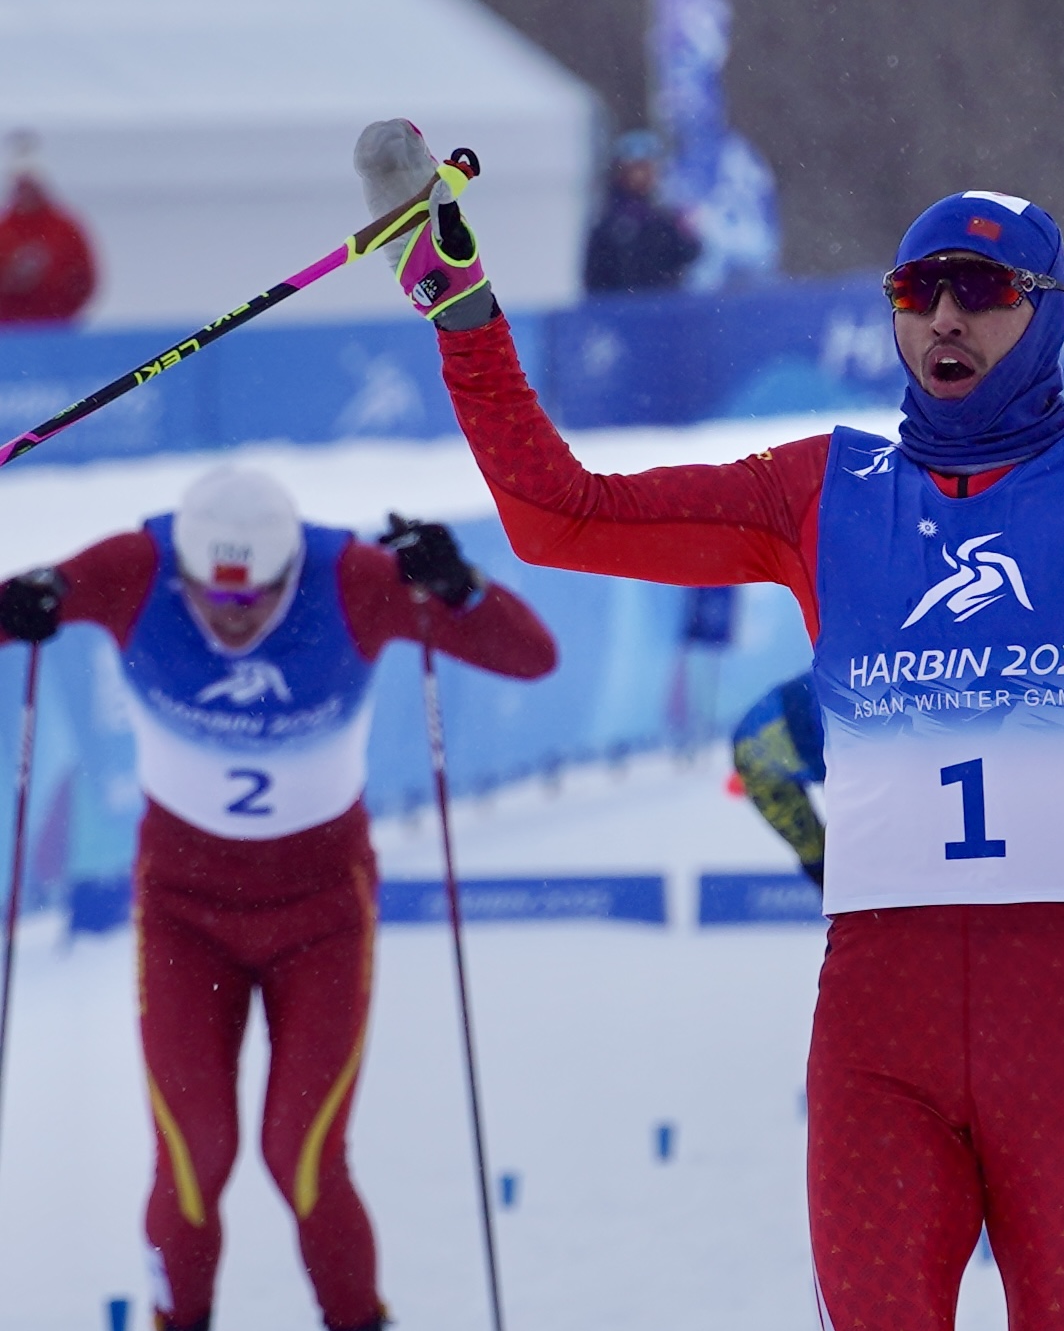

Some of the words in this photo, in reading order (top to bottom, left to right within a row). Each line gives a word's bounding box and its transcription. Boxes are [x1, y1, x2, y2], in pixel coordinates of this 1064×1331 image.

[134, 338, 200, 386] LEKI
[850, 646, 992, 690] HARBIN
[854, 696, 904, 719] ASIAN
[915, 689, 1011, 711] WINTER
[226, 768, 273, 815] 2
[940, 757, 1006, 860] 1
